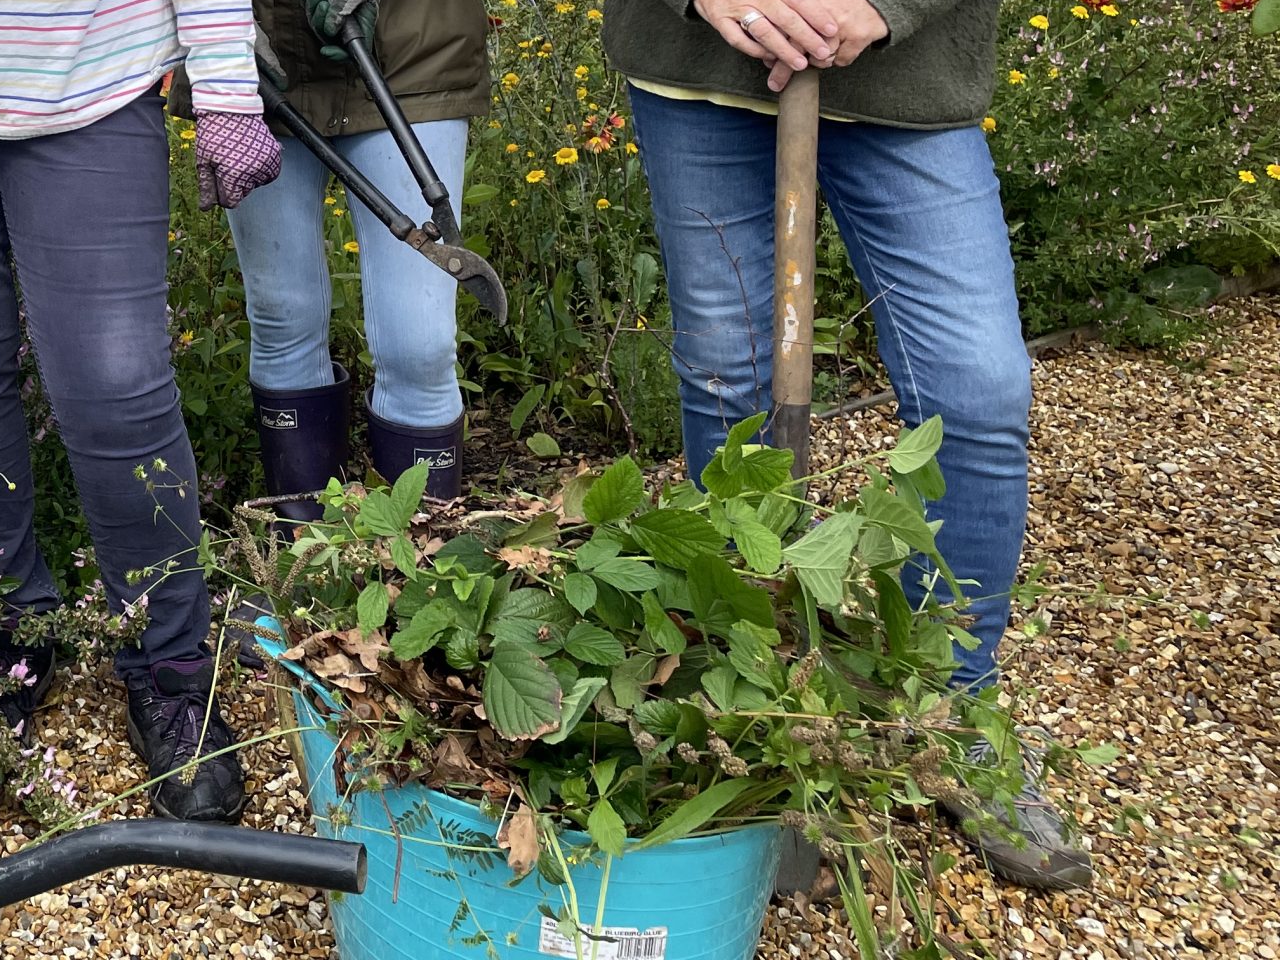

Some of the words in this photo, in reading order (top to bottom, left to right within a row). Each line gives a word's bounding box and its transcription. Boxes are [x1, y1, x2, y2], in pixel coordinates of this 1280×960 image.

[262, 415, 275, 426] Peter
[275, 418, 295, 427] Storm
[435, 458, 454, 467] Storm
